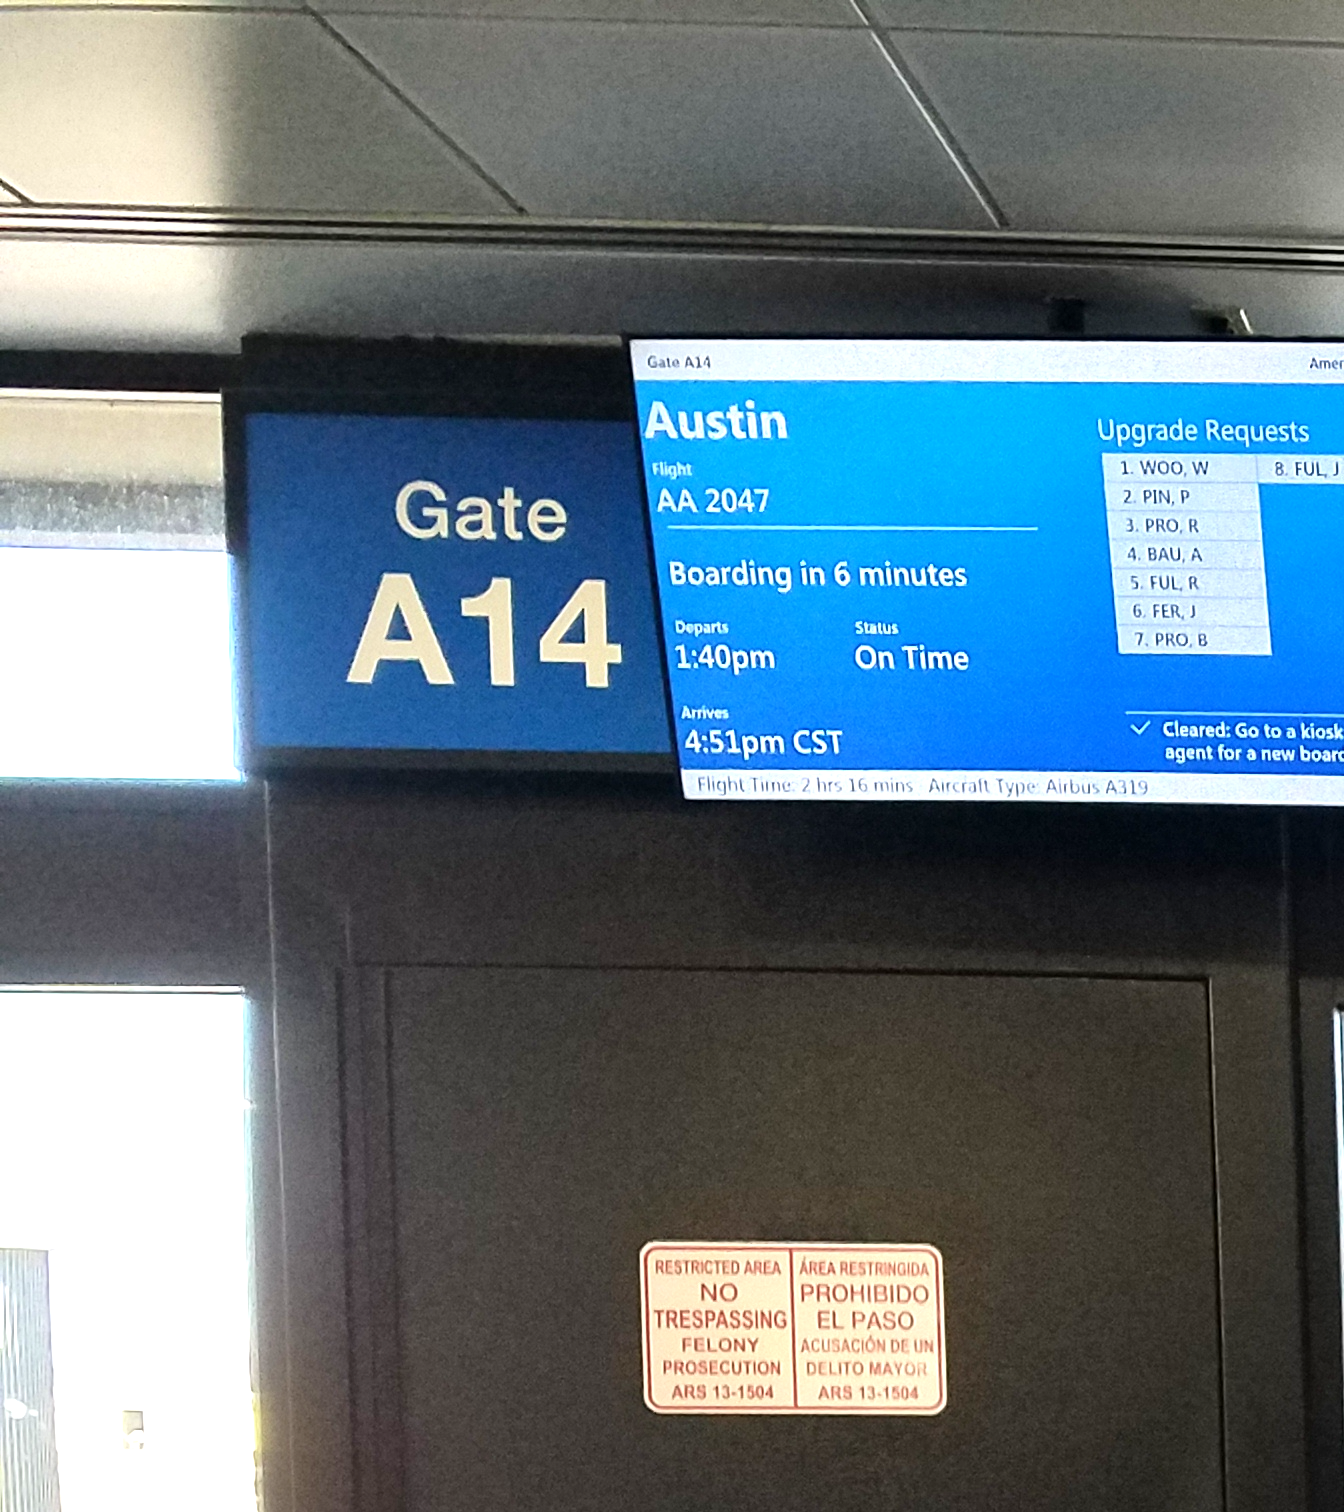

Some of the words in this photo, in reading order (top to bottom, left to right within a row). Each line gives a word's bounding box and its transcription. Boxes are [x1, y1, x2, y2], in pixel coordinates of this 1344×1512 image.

[647, 355, 680, 370] Gate
[684, 355, 711, 370] A14
[644, 400, 788, 441] Austin
[1098, 419, 1198, 447] Upgrade
[1206, 420, 1309, 447] Requests
[652, 462, 692, 479] Flight
[1121, 461, 1133, 475] 1.
[1140, 461, 1187, 477] WOO,
[1192, 462, 1209, 475] W
[1275, 462, 1288, 476] 8.
[1295, 462, 1326, 478] FUL,
[1333, 462, 1340, 477] J
[656, 489, 698, 513] AA
[705, 488, 769, 514] 2047
[1123, 490, 1136, 504] 2.
[1143, 490, 1174, 506] PIN,
[1180, 491, 1190, 504] P
[395, 479, 568, 542] Gate
[1126, 519, 1138, 532] 3.
[1145, 519, 1182, 535] PRO,
[1188, 520, 1199, 533] R
[1127, 548, 1141, 561] 4.
[1148, 548, 1185, 563] BAU,
[1190, 549, 1202, 562] A
[669, 562, 792, 594] Boarding
[801, 562, 825, 586] in
[834, 563, 851, 586] 6
[860, 562, 967, 587] minutes
[1131, 576, 1143, 590] 5.
[1150, 576, 1184, 592] FUL,
[1188, 577, 1199, 590] R
[1133, 605, 1145, 618] 6.
[1152, 605, 1184, 620] FER,
[1190, 605, 1196, 619] J
[346, 573, 622, 688] A14
[675, 620, 729, 638] Departs
[855, 620, 899, 635] Status
[1135, 633, 1148, 647] 7.
[1155, 633, 1193, 649] PRO,
[1198, 634, 1207, 647] B
[675, 644, 775, 675] 1:40pm
[855, 645, 896, 670] On
[903, 646, 969, 672] Time
[681, 706, 729, 720] Arrives
[1163, 723, 1230, 738] Cleared:
[1235, 724, 1259, 739] Go
[1264, 725, 1281, 739] to
[1287, 728, 1296, 740] a
[1302, 724, 1344, 741] kiosk
[685, 730, 785, 761] 4:51pm
[794, 730, 841, 755] CST
[1166, 746, 1212, 763] agent
[1218, 746, 1241, 761] for
[1247, 750, 1256, 761] a
[1261, 750, 1295, 762] new
[697, 775, 745, 797] Flight
[750, 776, 795, 795] Time:
[802, 777, 811, 793] 2
[815, 776, 842, 794] hrs
[848, 777, 867, 793] 16
[872, 777, 913, 794] mins
[928, 777, 993, 796] Aircraft
[999, 778, 1040, 800] Type:
[1046, 779, 1099, 795] Airbus
[1106, 781, 1148, 795] A319
[656, 1261, 739, 1275] RESTRICTED
[744, 1261, 781, 1275] AREA
[840, 1262, 929, 1277] RESTRINGIDA
[701, 1283, 738, 1302] NO
[801, 1284, 929, 1303] PROHIBIDO
[654, 1310, 787, 1329] TRESPASSING
[818, 1311, 843, 1329] EL
[852, 1312, 914, 1330] PASO
[682, 1338, 759, 1352] FELONY
[891, 1339, 909, 1352] DE
[914, 1339, 934, 1353] UN
[663, 1361, 781, 1375] PROSECUTION
[807, 1362, 863, 1375] DELITO
[870, 1362, 927, 1376] MAYOR
[672, 1385, 706, 1400] ARS
[713, 1385, 774, 1400] 13-1504
[819, 1386, 852, 1400] ARS
[859, 1386, 918, 1400] 13-1504
